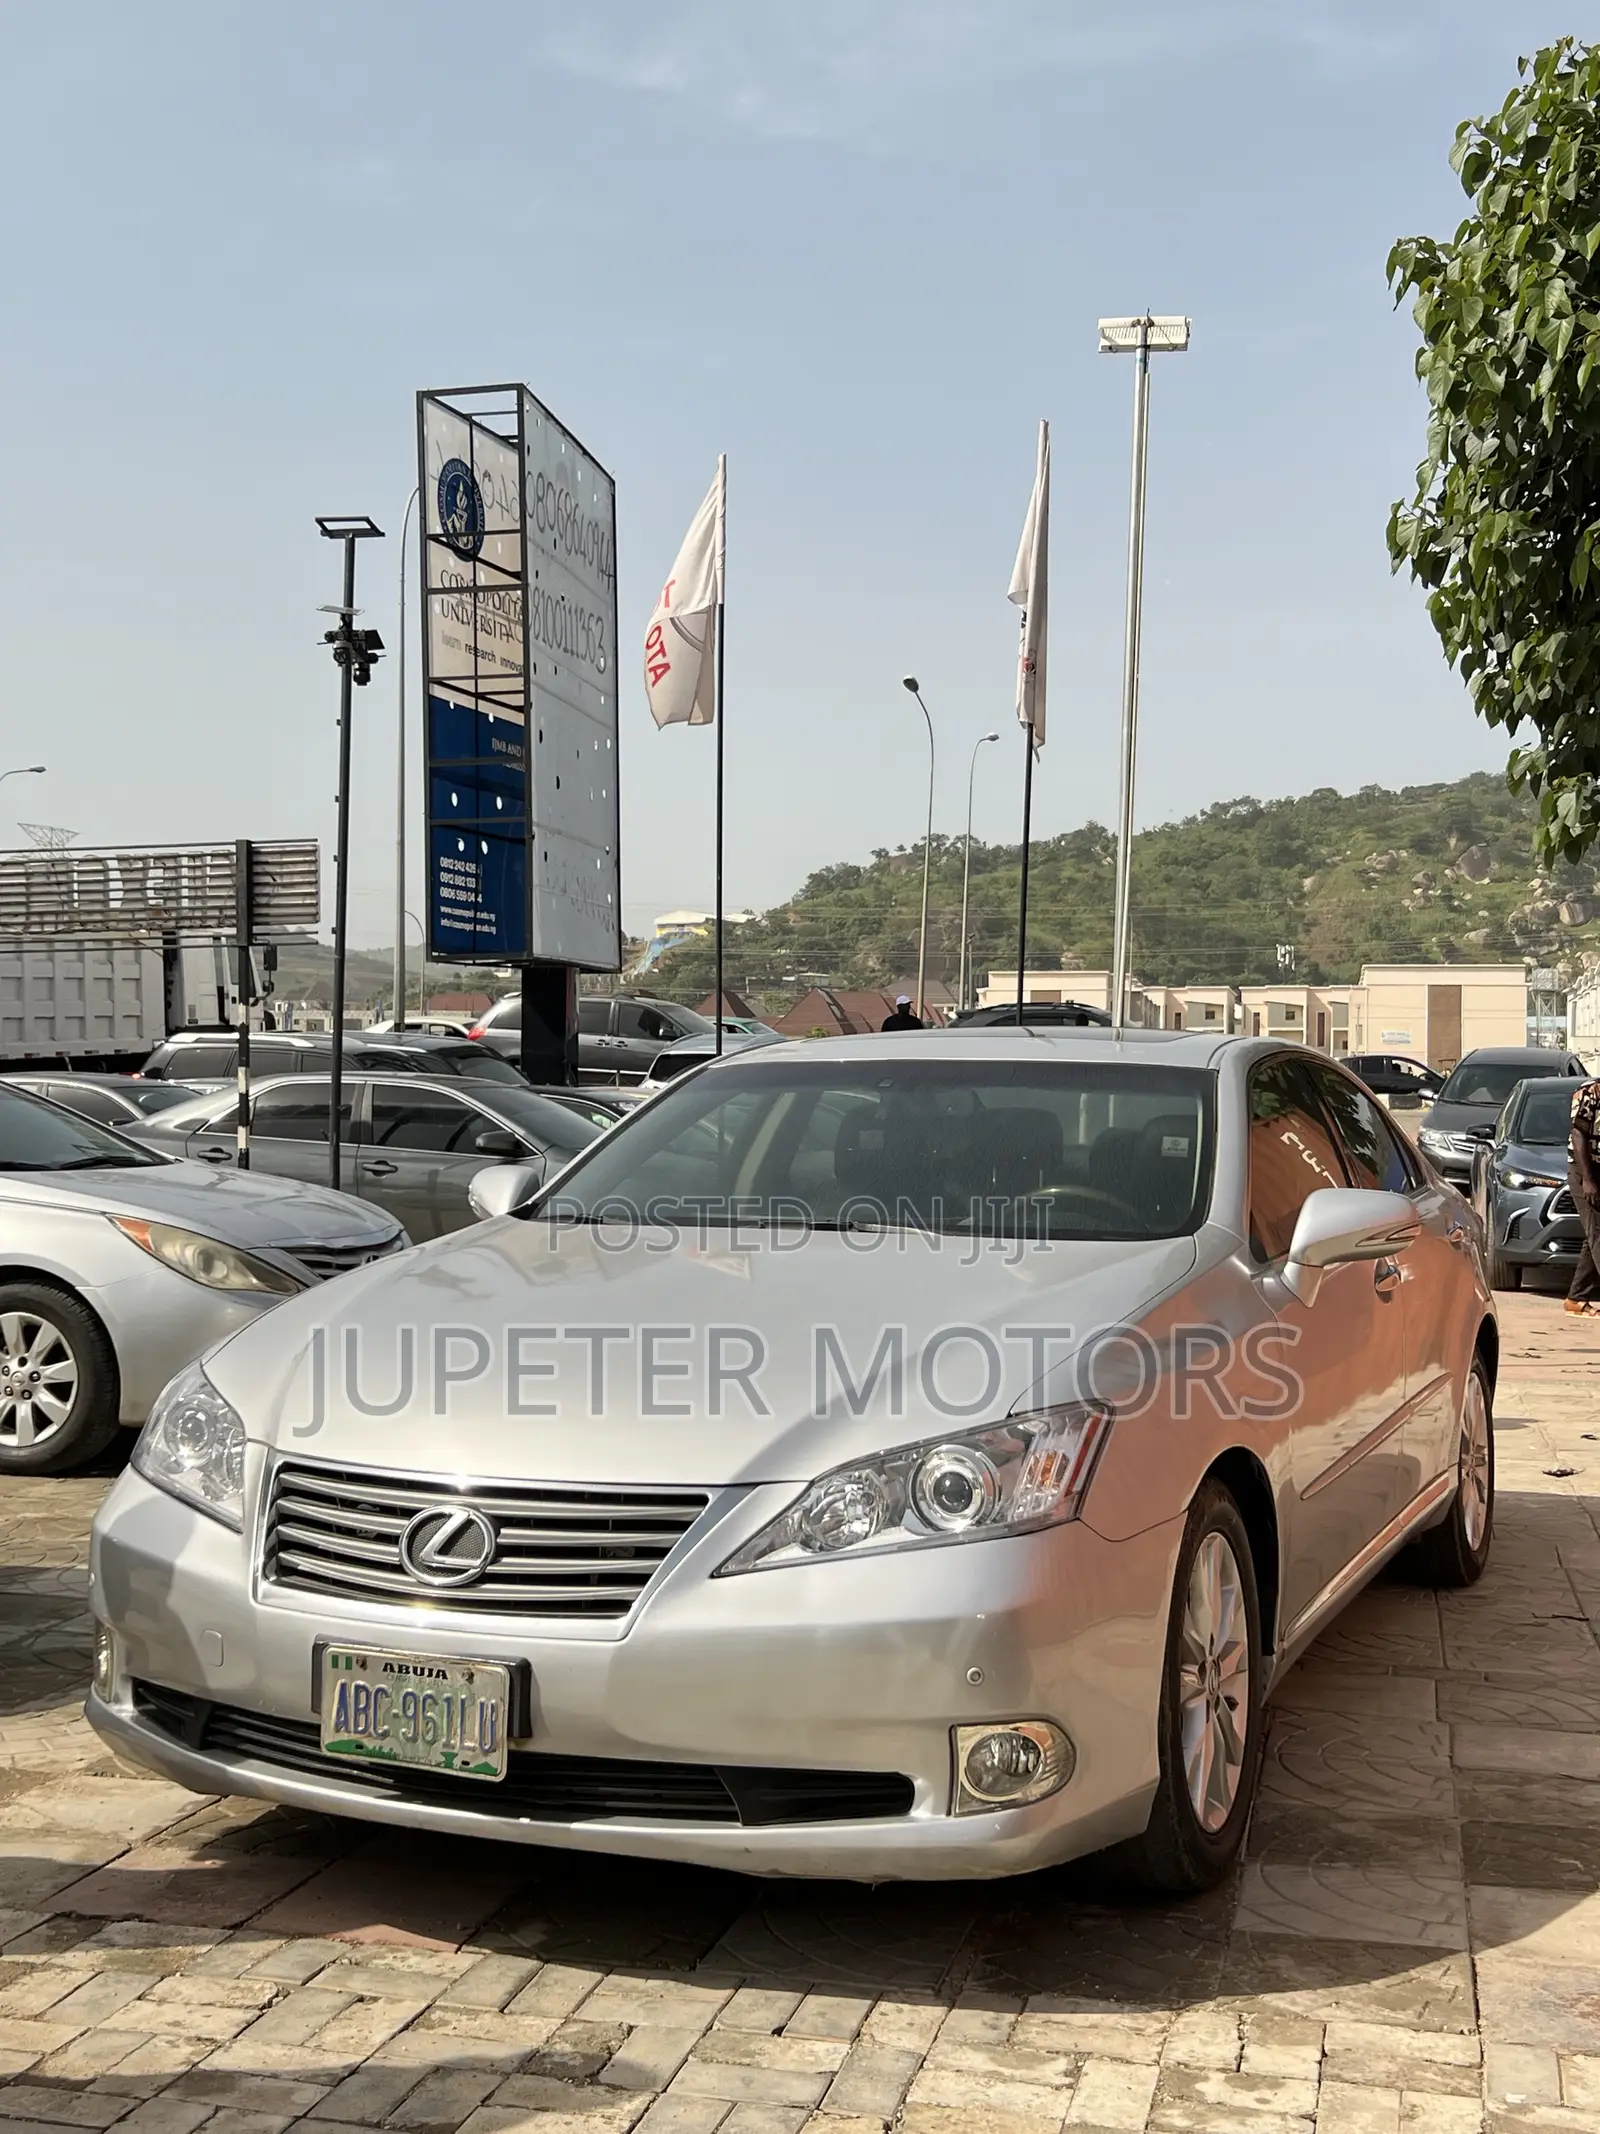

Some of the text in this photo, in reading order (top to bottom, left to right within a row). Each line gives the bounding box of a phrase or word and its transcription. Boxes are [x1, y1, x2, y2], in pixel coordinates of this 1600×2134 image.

[465, 643, 497, 664] research
[507, 743, 522, 757] AND
[382, 1662, 449, 1681] ABUJA
